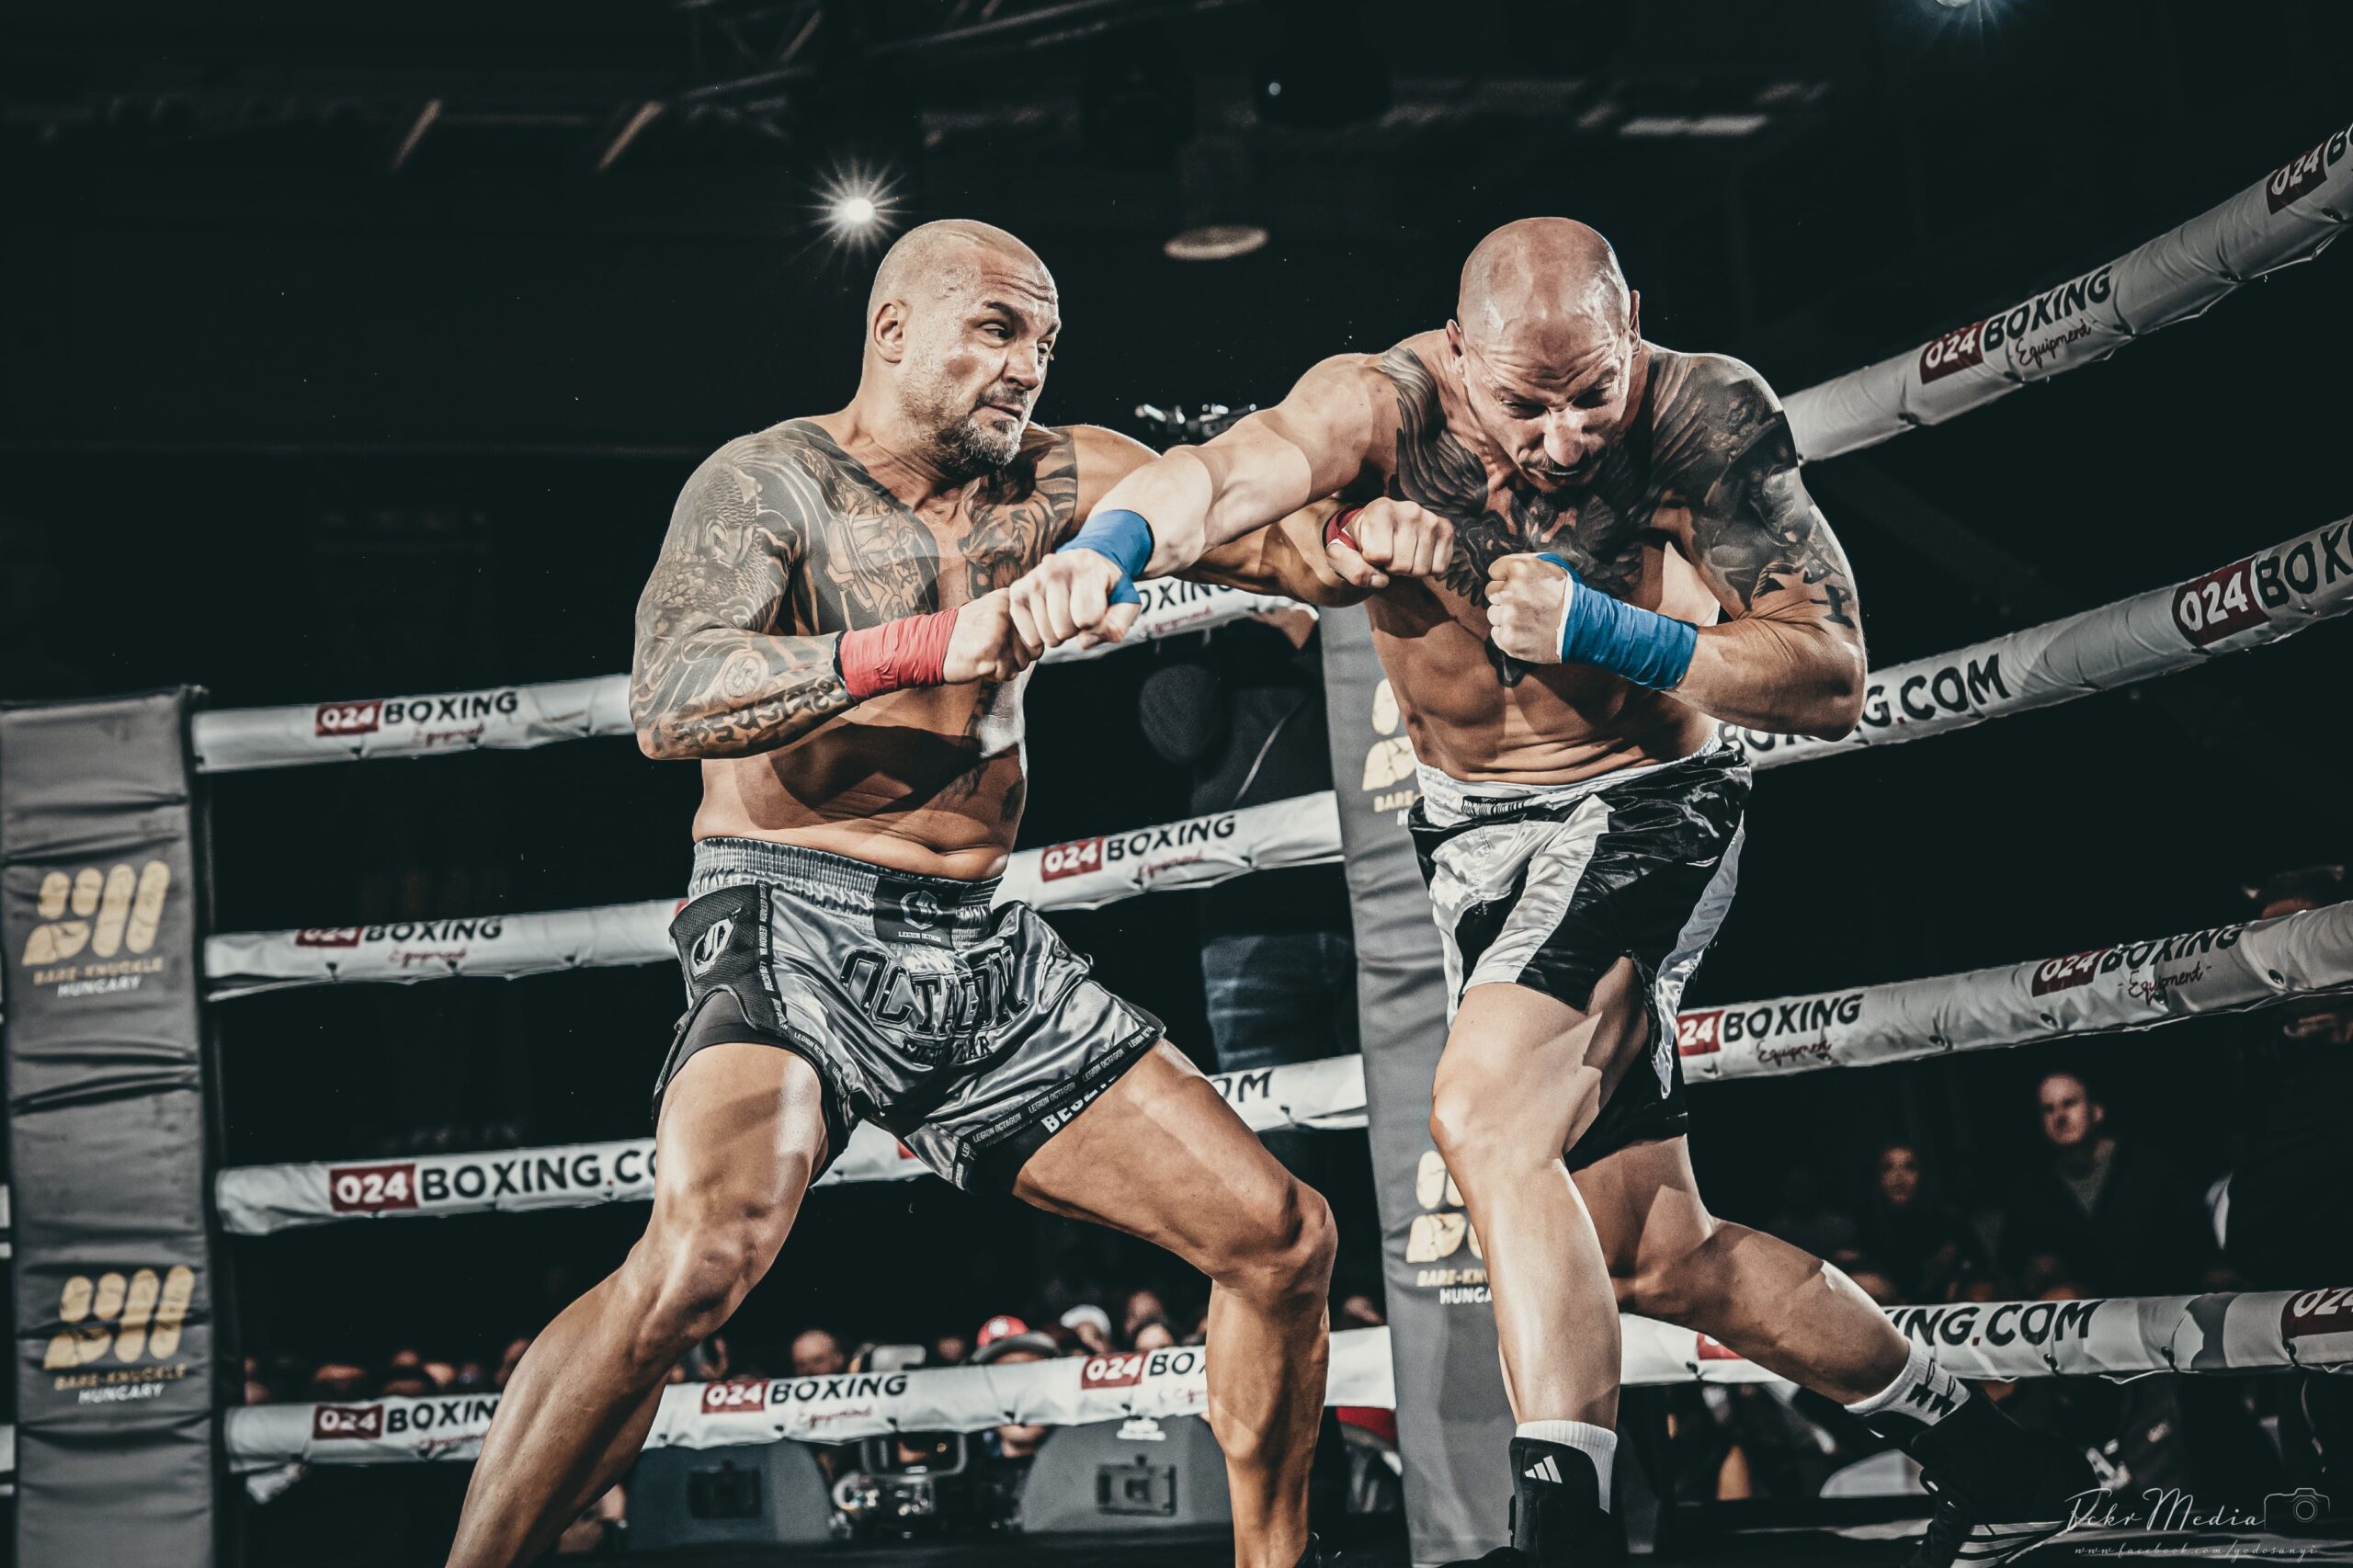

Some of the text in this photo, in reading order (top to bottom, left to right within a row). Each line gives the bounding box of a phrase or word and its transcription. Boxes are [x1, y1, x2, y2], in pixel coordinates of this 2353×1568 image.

[1926, 265, 2112, 369] 024 BOXING
[2179, 520, 2353, 632] 024 BOX
[322, 691, 518, 730] 024 BOXING
[1043, 840, 1098, 873] 024
[1107, 814, 1236, 862] BOXING
[364, 918, 502, 943] BOXING
[2040, 926, 2244, 983] 024 BOXING
[1677, 994, 1864, 1048] 24 BOXING
[336, 1172, 409, 1204] 024
[1086, 1352, 1206, 1381] 024 BO
[78, 1382, 165, 1404] HUNGARY
[706, 1374, 907, 1407] 024 BOXING
[319, 1398, 500, 1434] 024 BOXIN
